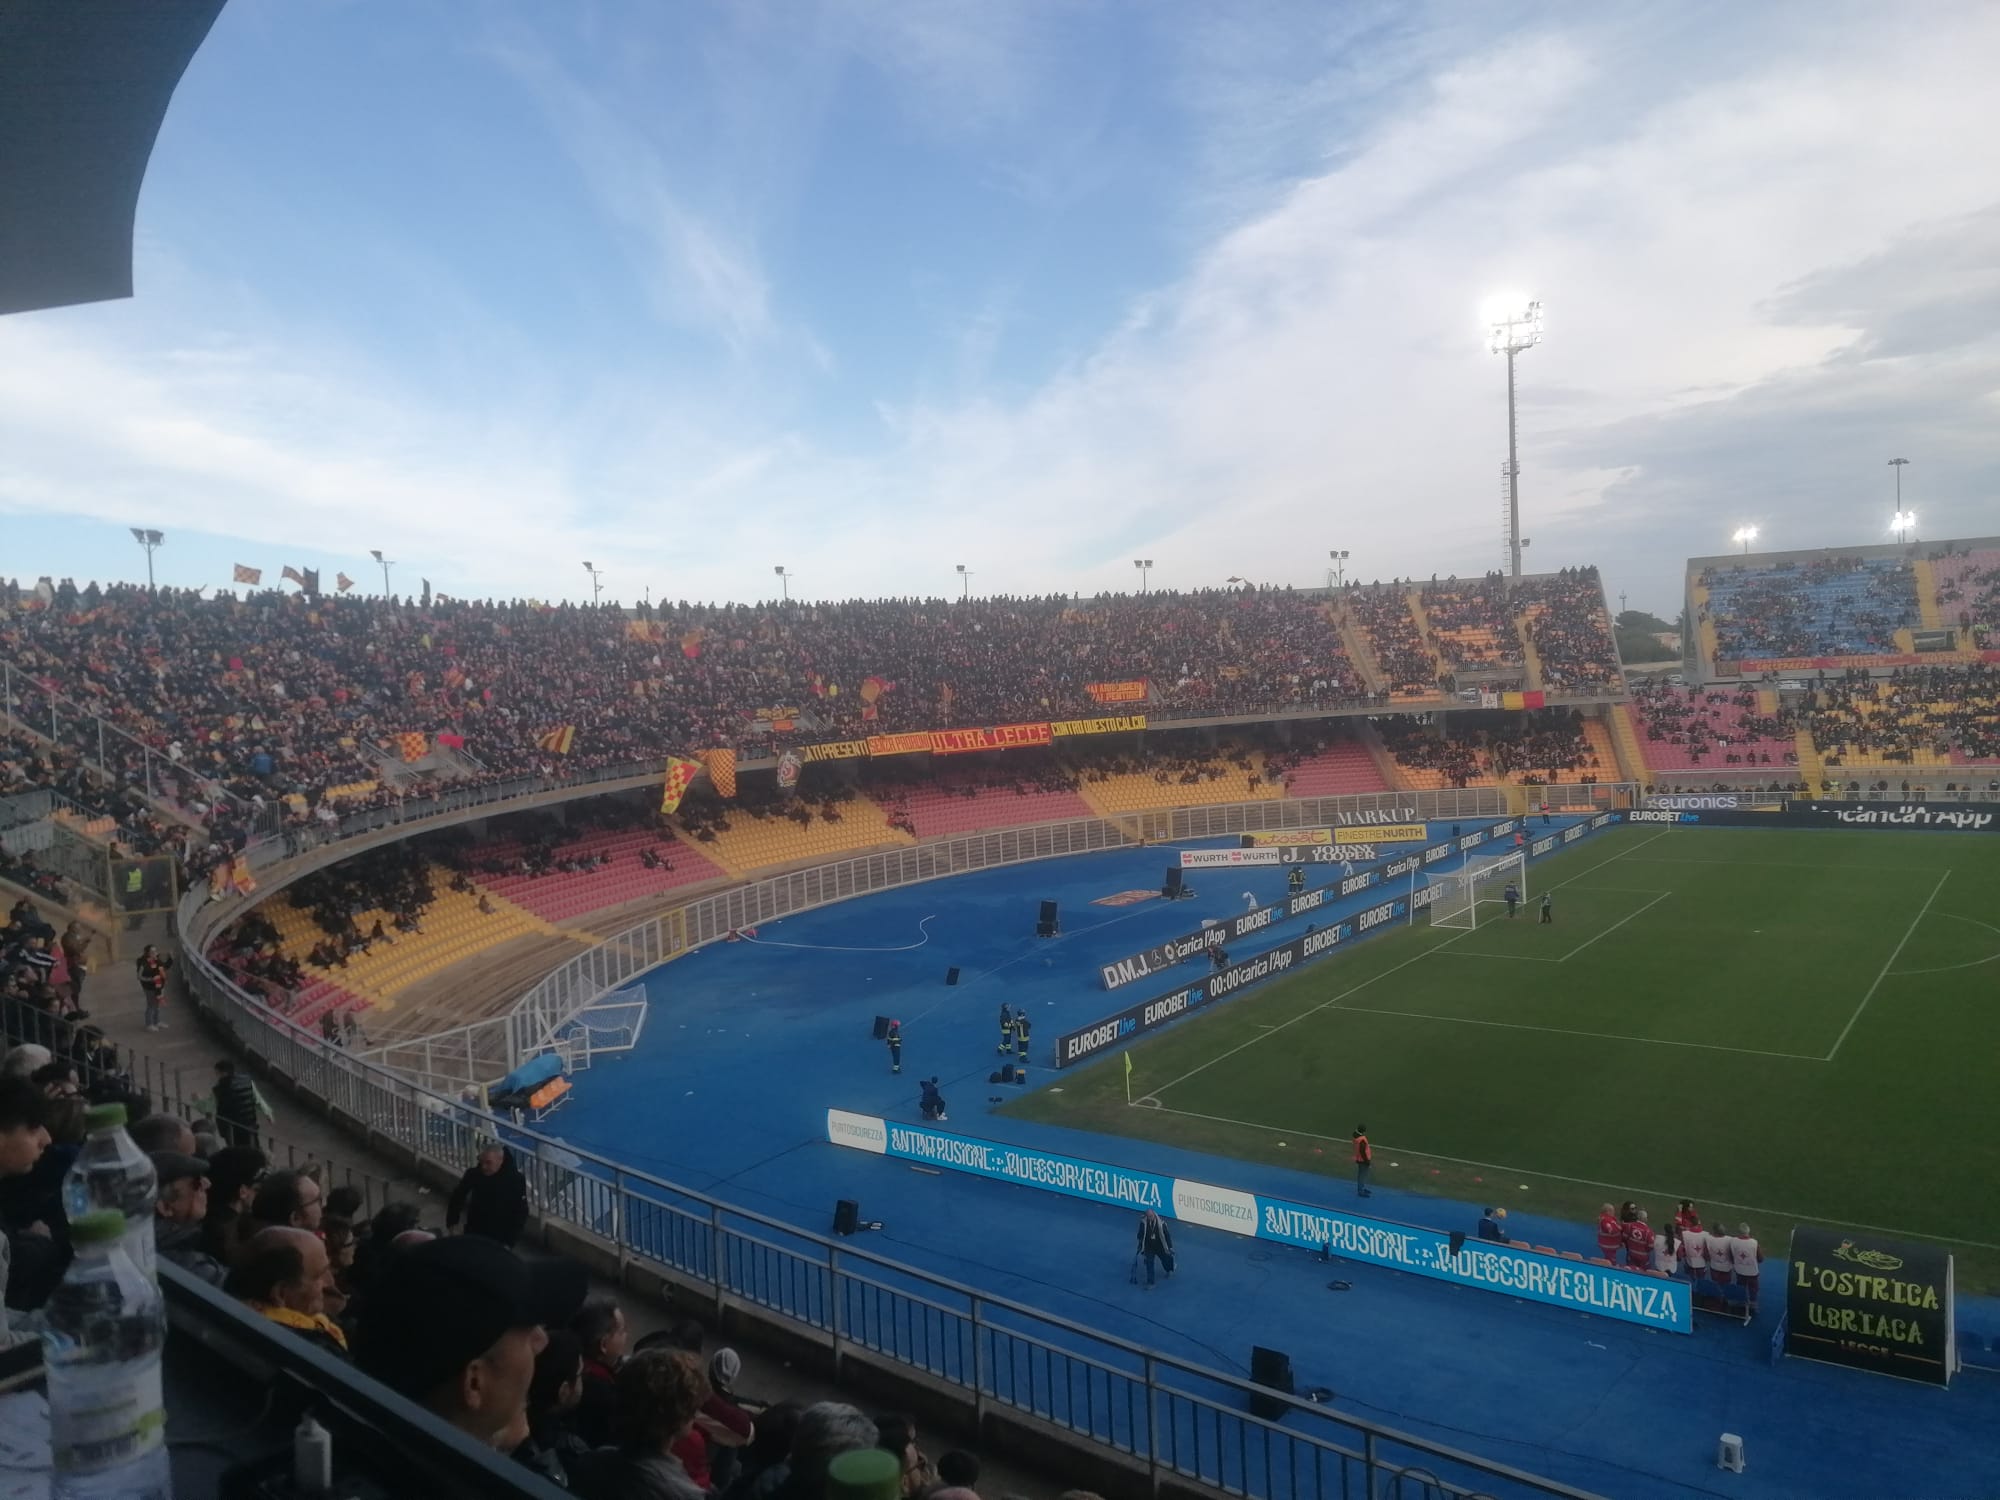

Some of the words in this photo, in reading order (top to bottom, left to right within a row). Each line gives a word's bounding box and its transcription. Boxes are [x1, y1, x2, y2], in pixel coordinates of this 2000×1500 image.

[929, 731, 987, 751] ULTRA
[994, 726, 1049, 746] LECCE
[1657, 796, 1738, 810] euronics
[1336, 808, 1415, 825] MARKUP
[1178, 1193, 1253, 1221] PUNTOSICUREZZA
[1795, 1261, 1938, 1310] L'OSTRICA
[1808, 1302, 1924, 1345] UBRIACA
